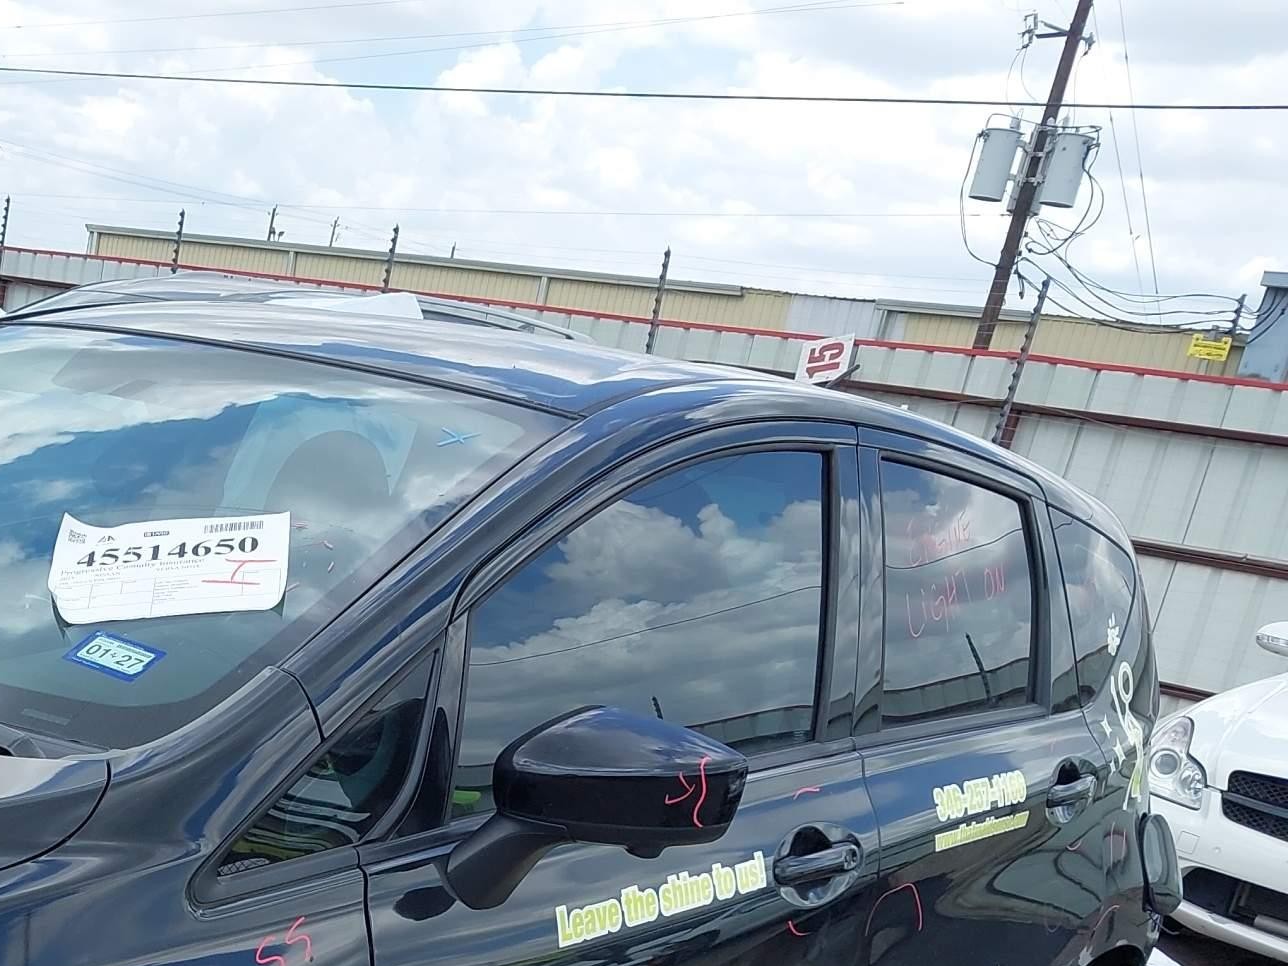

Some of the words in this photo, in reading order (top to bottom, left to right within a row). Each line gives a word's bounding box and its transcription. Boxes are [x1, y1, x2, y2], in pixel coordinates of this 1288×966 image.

[806, 342, 845, 379] 15
[76, 536, 260, 568] 45514650
[556, 899, 622, 948] Leave
[621, 885, 659, 927] the
[659, 871, 714, 917] shine
[712, 863, 736, 901] to
[735, 851, 767, 894] us!
